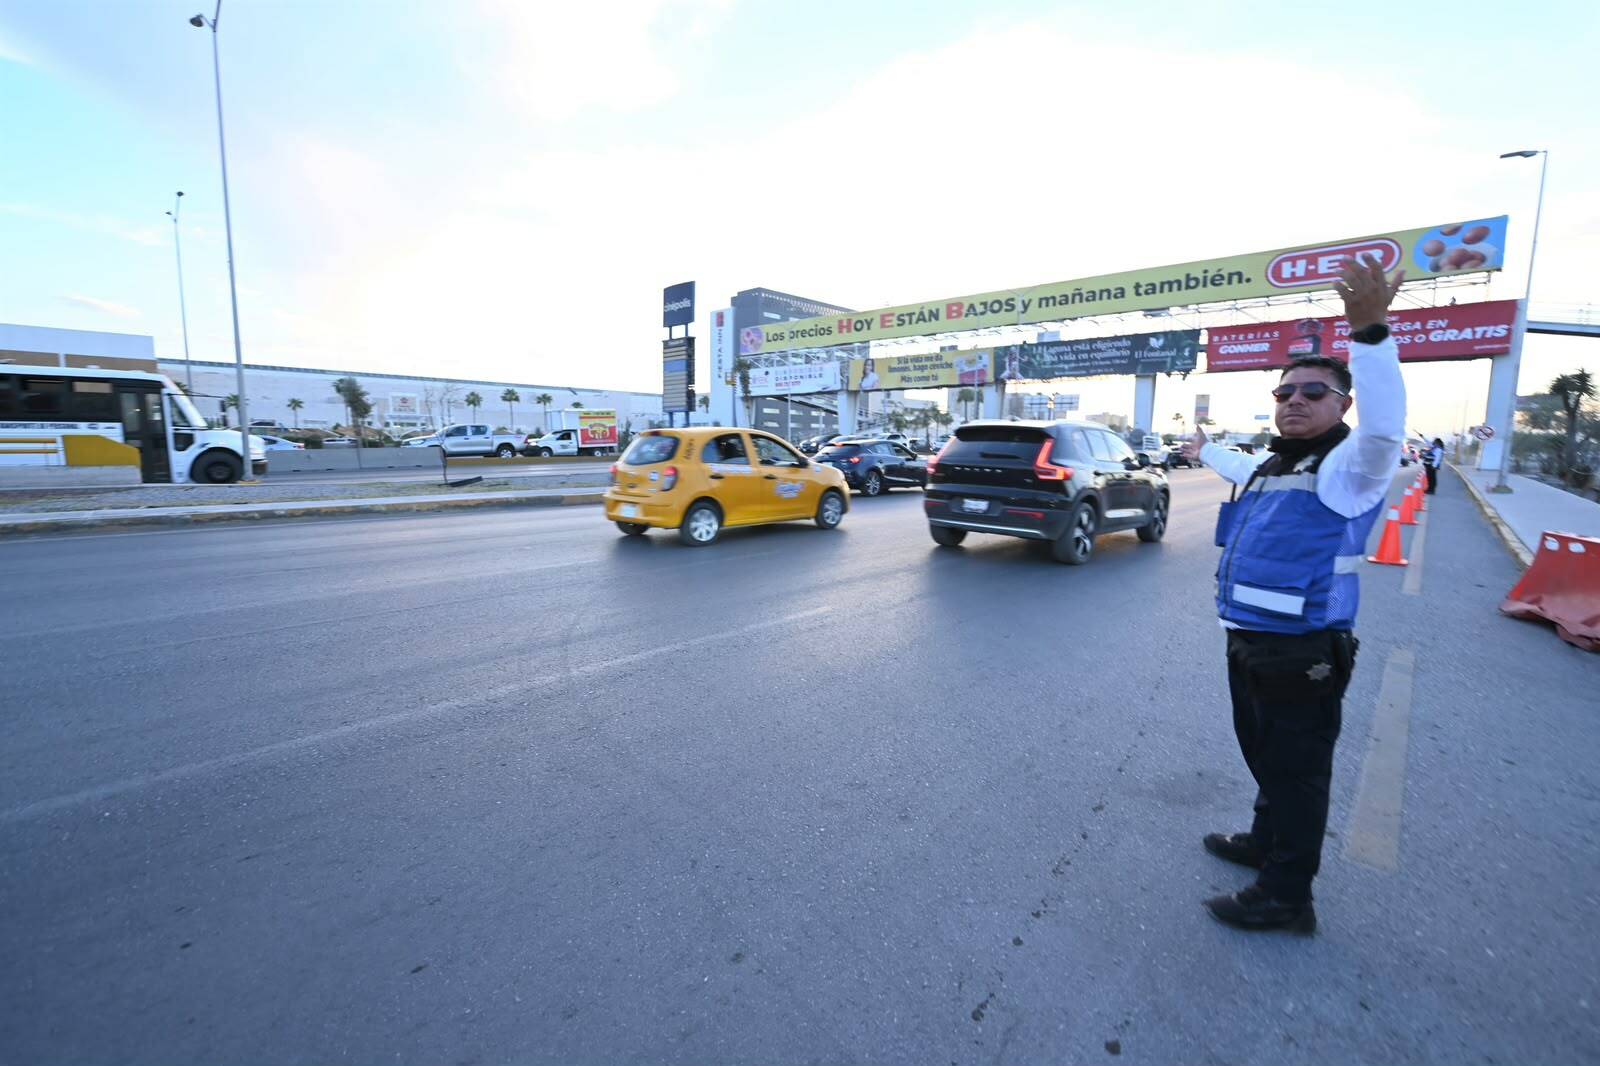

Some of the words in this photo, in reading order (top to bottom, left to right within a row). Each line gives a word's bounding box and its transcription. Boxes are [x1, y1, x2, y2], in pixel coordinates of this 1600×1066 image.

[766, 332, 785, 343] Los
[789, 324, 833, 342] precios
[838, 318, 874, 334] HOY
[879, 306, 940, 328] ESTÁN
[945, 297, 1016, 320] BAJOS
[1020, 299, 1032, 314] y
[1038, 286, 1126, 309] mañana
[1134, 268, 1252, 297] también.
[1425, 318, 1449, 330] EN
[1428, 324, 1509, 343] GRATIS
